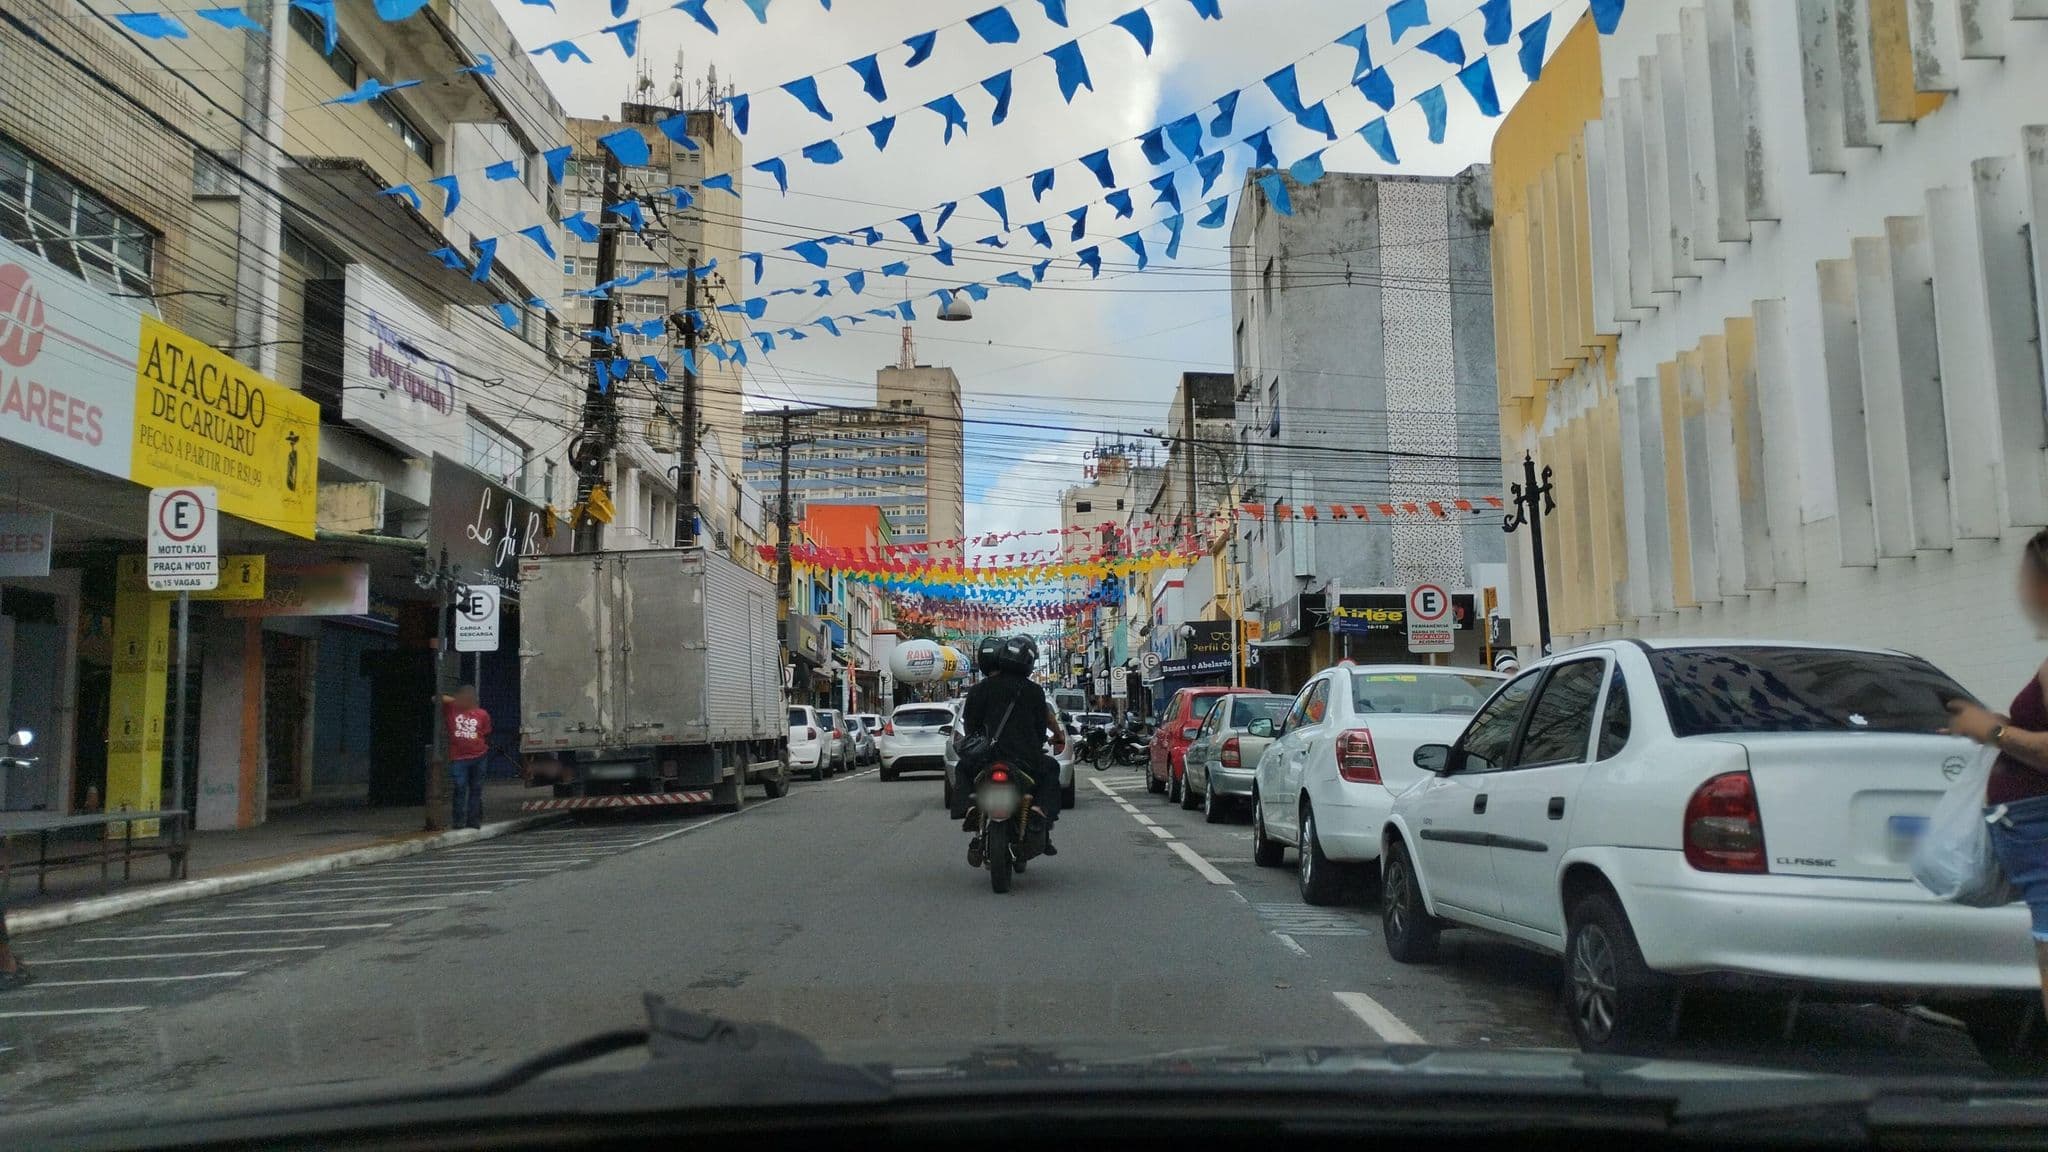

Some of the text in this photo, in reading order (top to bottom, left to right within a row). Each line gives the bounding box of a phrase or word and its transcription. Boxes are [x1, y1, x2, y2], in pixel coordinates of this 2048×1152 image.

[143, 336, 265, 428] ATACADO
[0, 368, 103, 447] AREES
[152, 386, 257, 457] DE CARUARU
[175, 438, 183, 459] A
[184, 441, 222, 474] PARTIR
[223, 456, 236, 480] DE
[175, 502, 189, 529] E
[467, 487, 493, 546] Le
[158, 545, 182, 554] MOTO
[153, 562, 182, 573] PRAÇA
[163, 578, 201, 587] 15 VAGAS
[472, 597, 483, 616] E
[1423, 592, 1436, 612] E
[1148, 657, 1155, 666] E
[1198, 660, 1232, 669] Abelardo
[1776, 857, 1837, 867] CLASSIC
